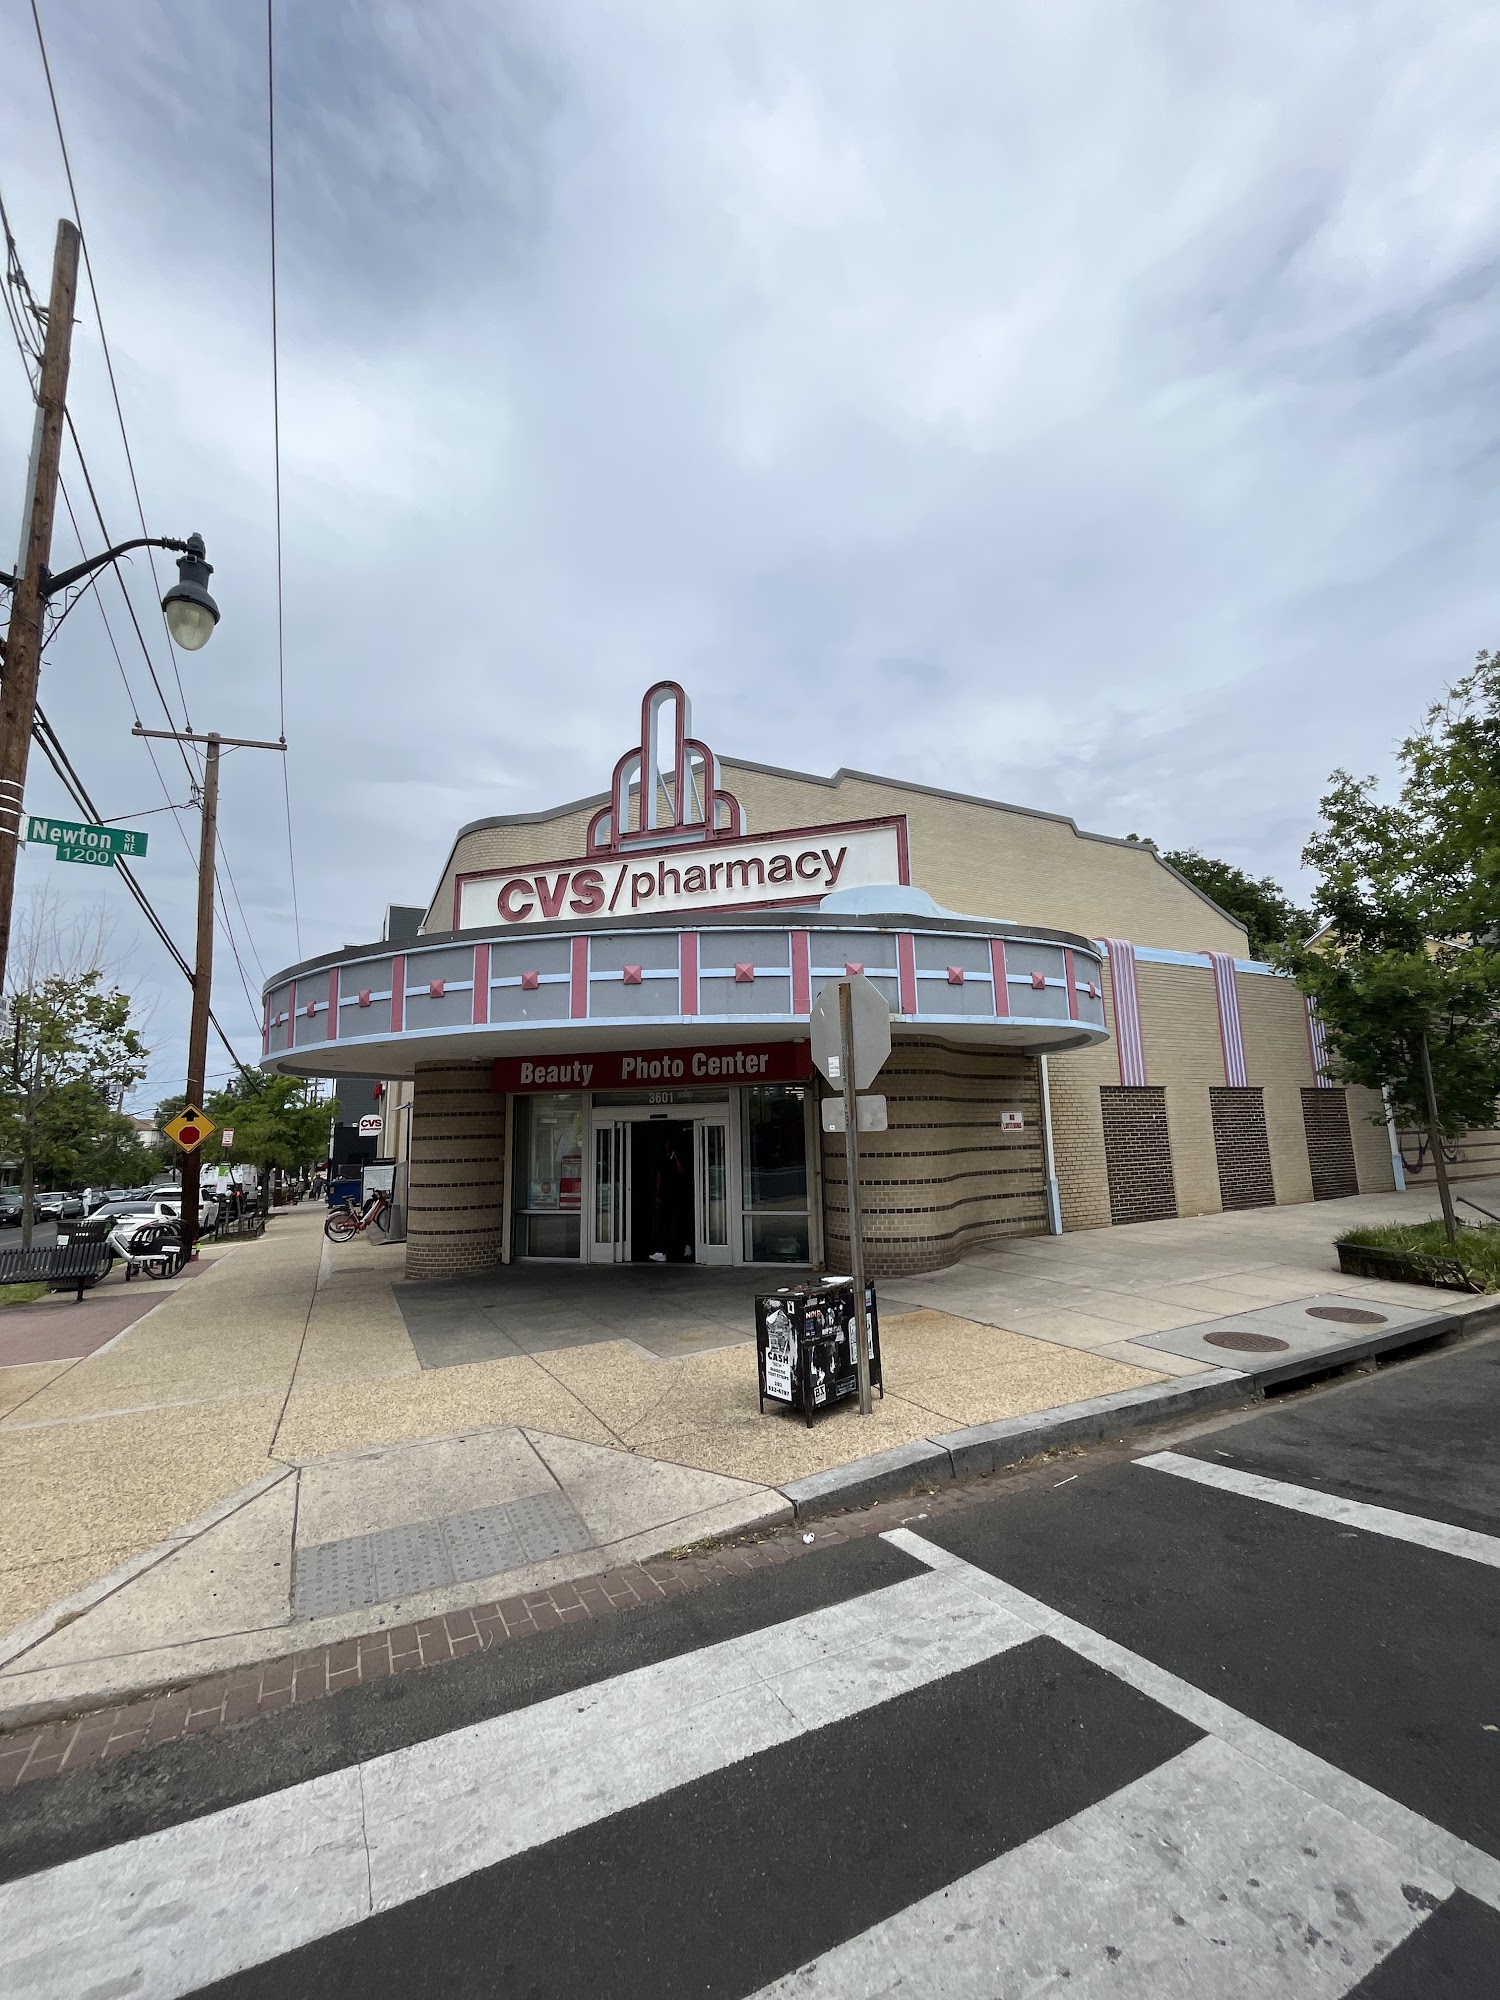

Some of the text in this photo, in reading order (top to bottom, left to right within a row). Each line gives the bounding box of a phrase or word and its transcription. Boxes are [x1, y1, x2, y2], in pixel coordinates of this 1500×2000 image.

[32, 820, 136, 849] Newton St
[123, 842, 135, 853] NE
[62, 847, 109, 864] 1200
[520, 1051, 769, 1087] Beauty Photo Center
[649, 1091, 674, 1104] 3601
[361, 1119, 382, 1128] CVS
[768, 1352, 789, 1365] CASH
